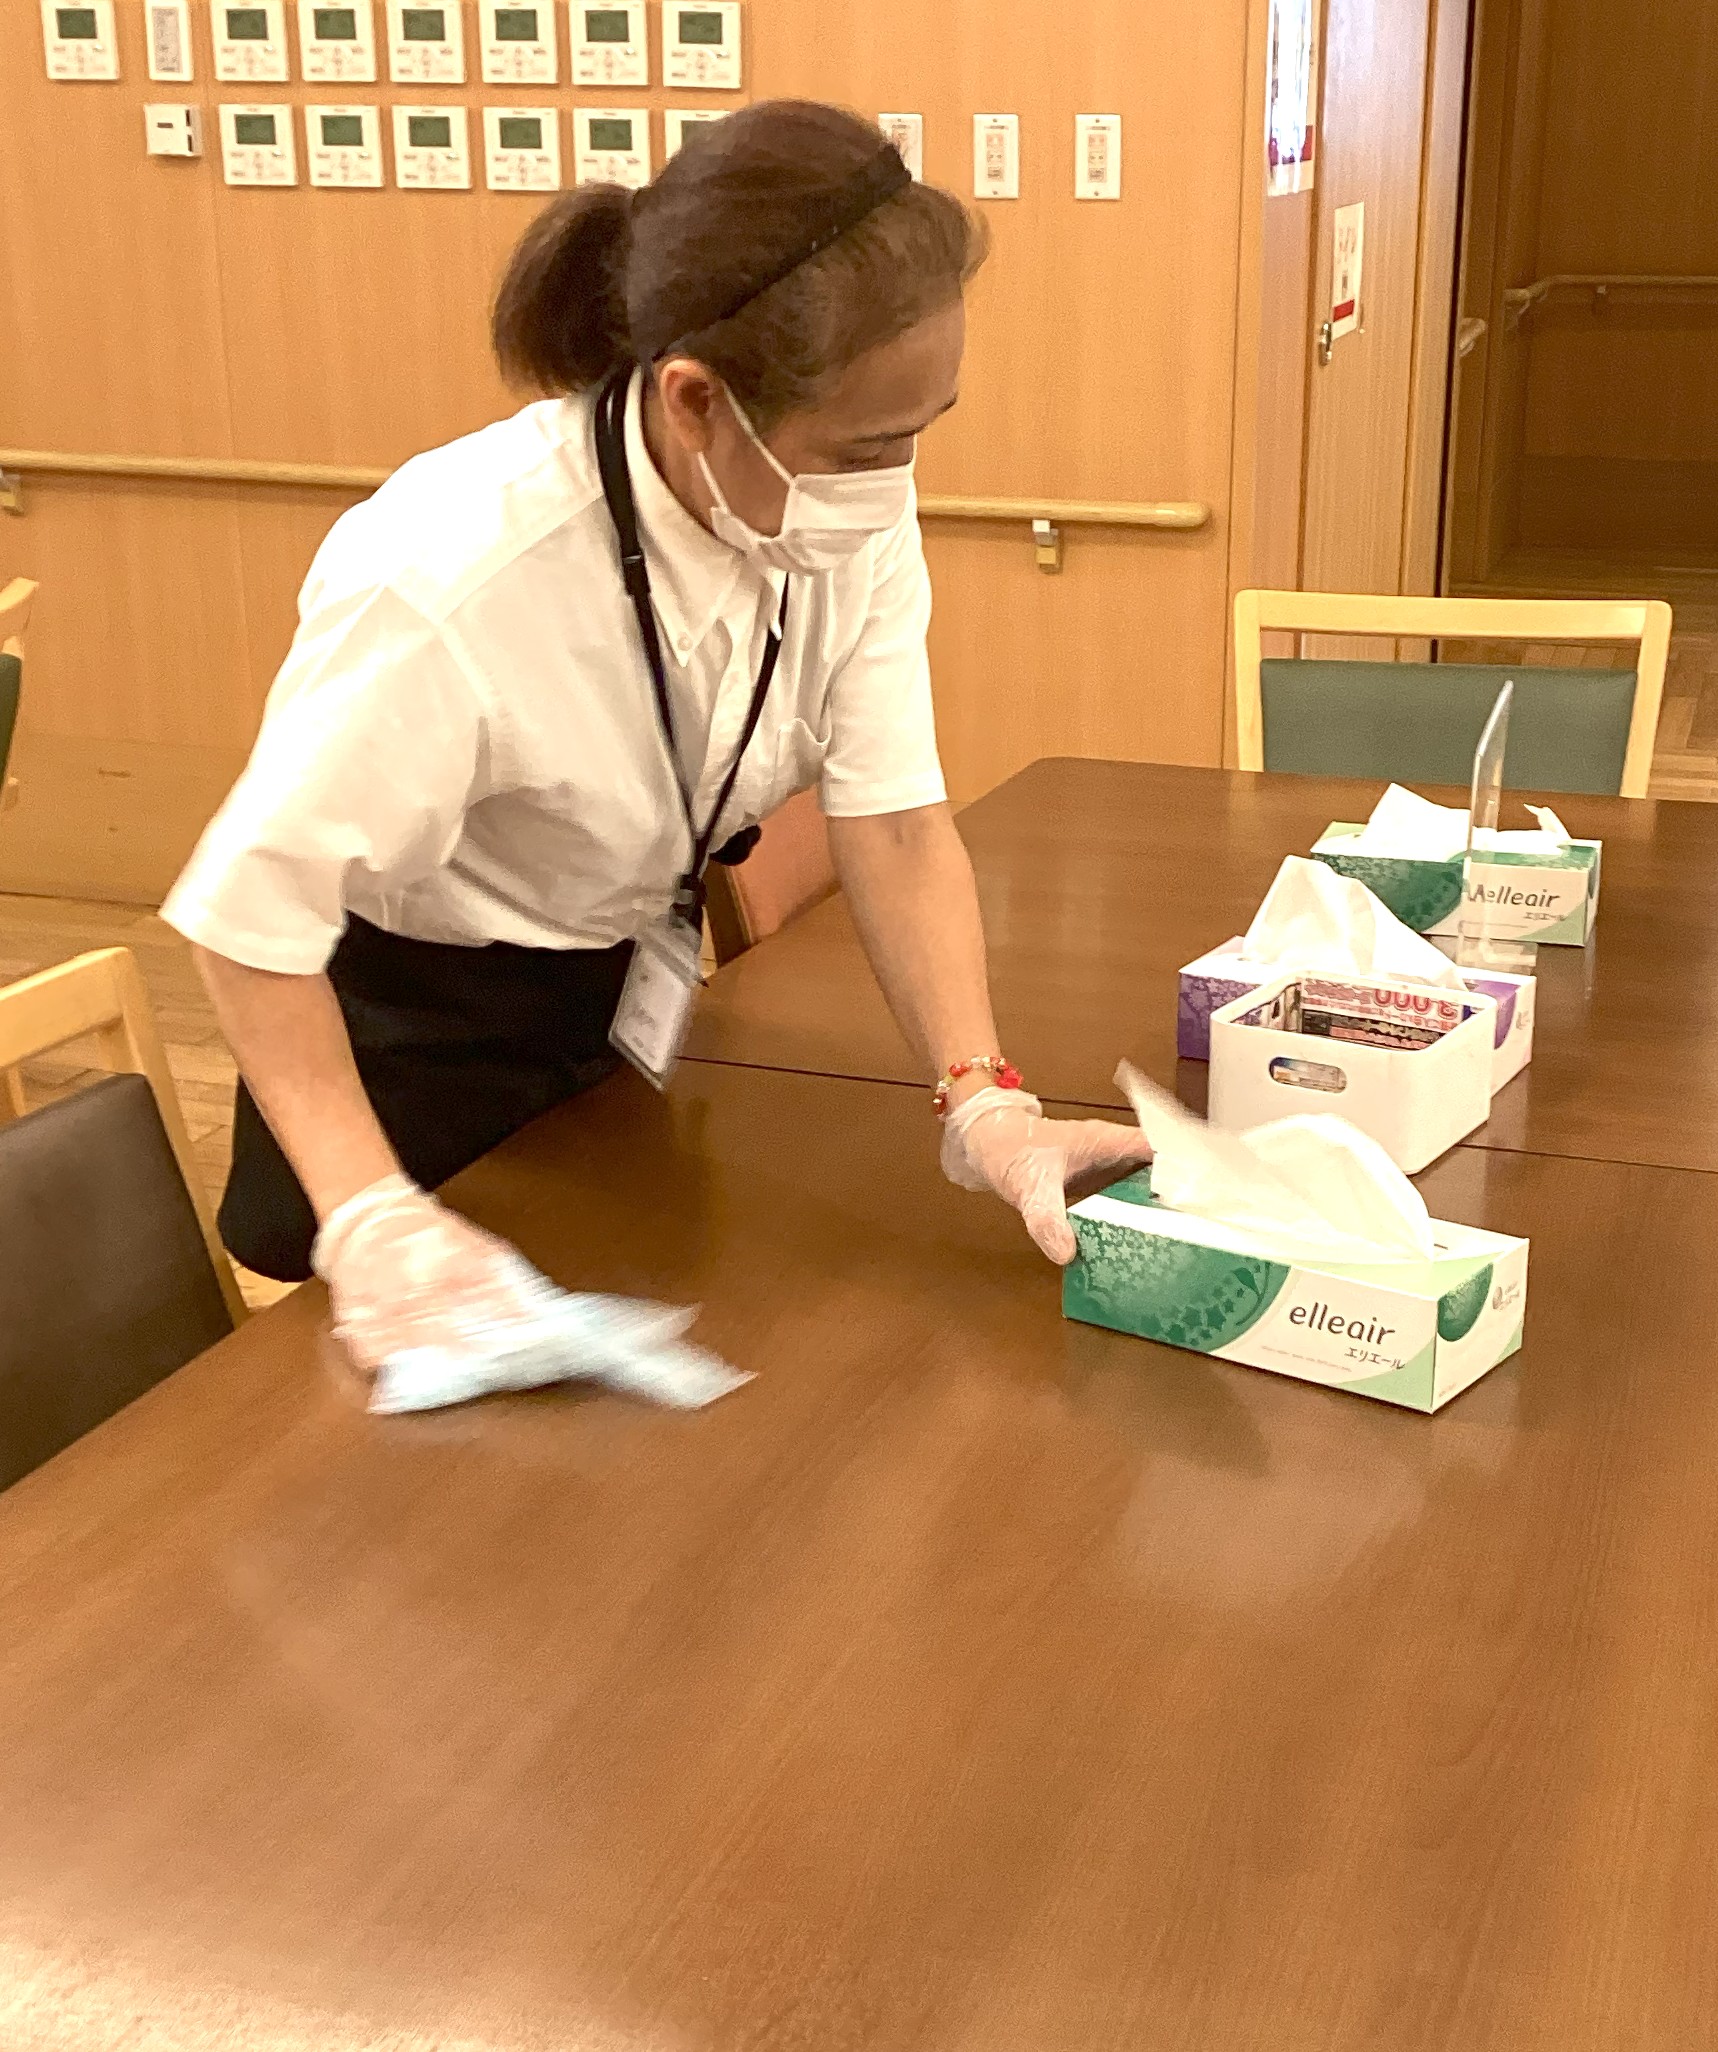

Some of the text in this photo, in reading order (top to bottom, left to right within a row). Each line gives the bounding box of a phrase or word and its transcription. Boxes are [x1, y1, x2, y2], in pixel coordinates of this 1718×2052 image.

[1289, 1301, 1396, 1345] elleair
[1343, 1346, 1406, 1370] エリエール
